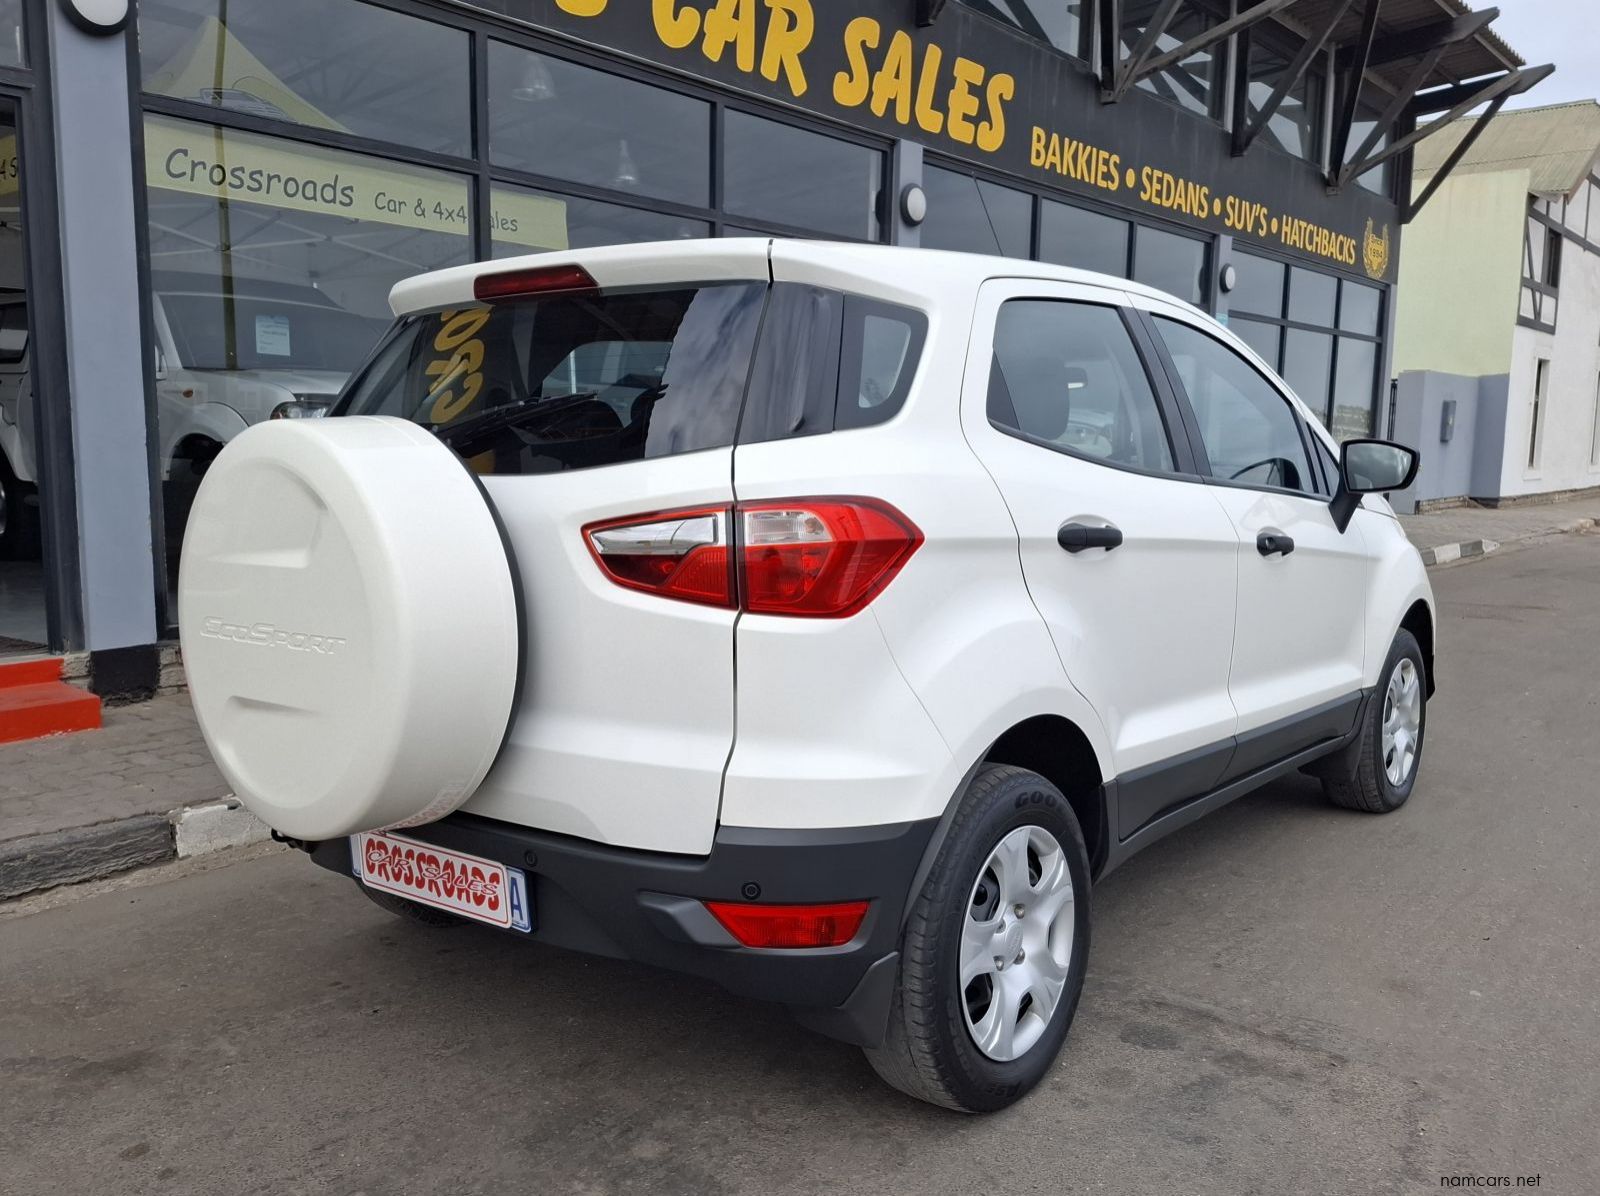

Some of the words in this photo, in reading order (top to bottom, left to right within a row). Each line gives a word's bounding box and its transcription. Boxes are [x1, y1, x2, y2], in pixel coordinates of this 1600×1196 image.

[833, 16, 1014, 152] SALES
[165, 148, 354, 208] Crossroads
[374, 191, 407, 215] Car
[414, 201, 427, 218] &
[433, 200, 467, 224] 4x4
[489, 211, 518, 232] ales
[1030, 125, 1120, 192] BAKKIES
[1140, 165, 1209, 219] SEDANS
[1224, 196, 1268, 238] SUV'S
[1281, 214, 1356, 265] HATCHBACKS
[365, 838, 500, 911] CROSSROADS
[368, 851, 409, 872] CAR
[422, 867, 498, 897] SALES
[510, 876, 524, 921] A
